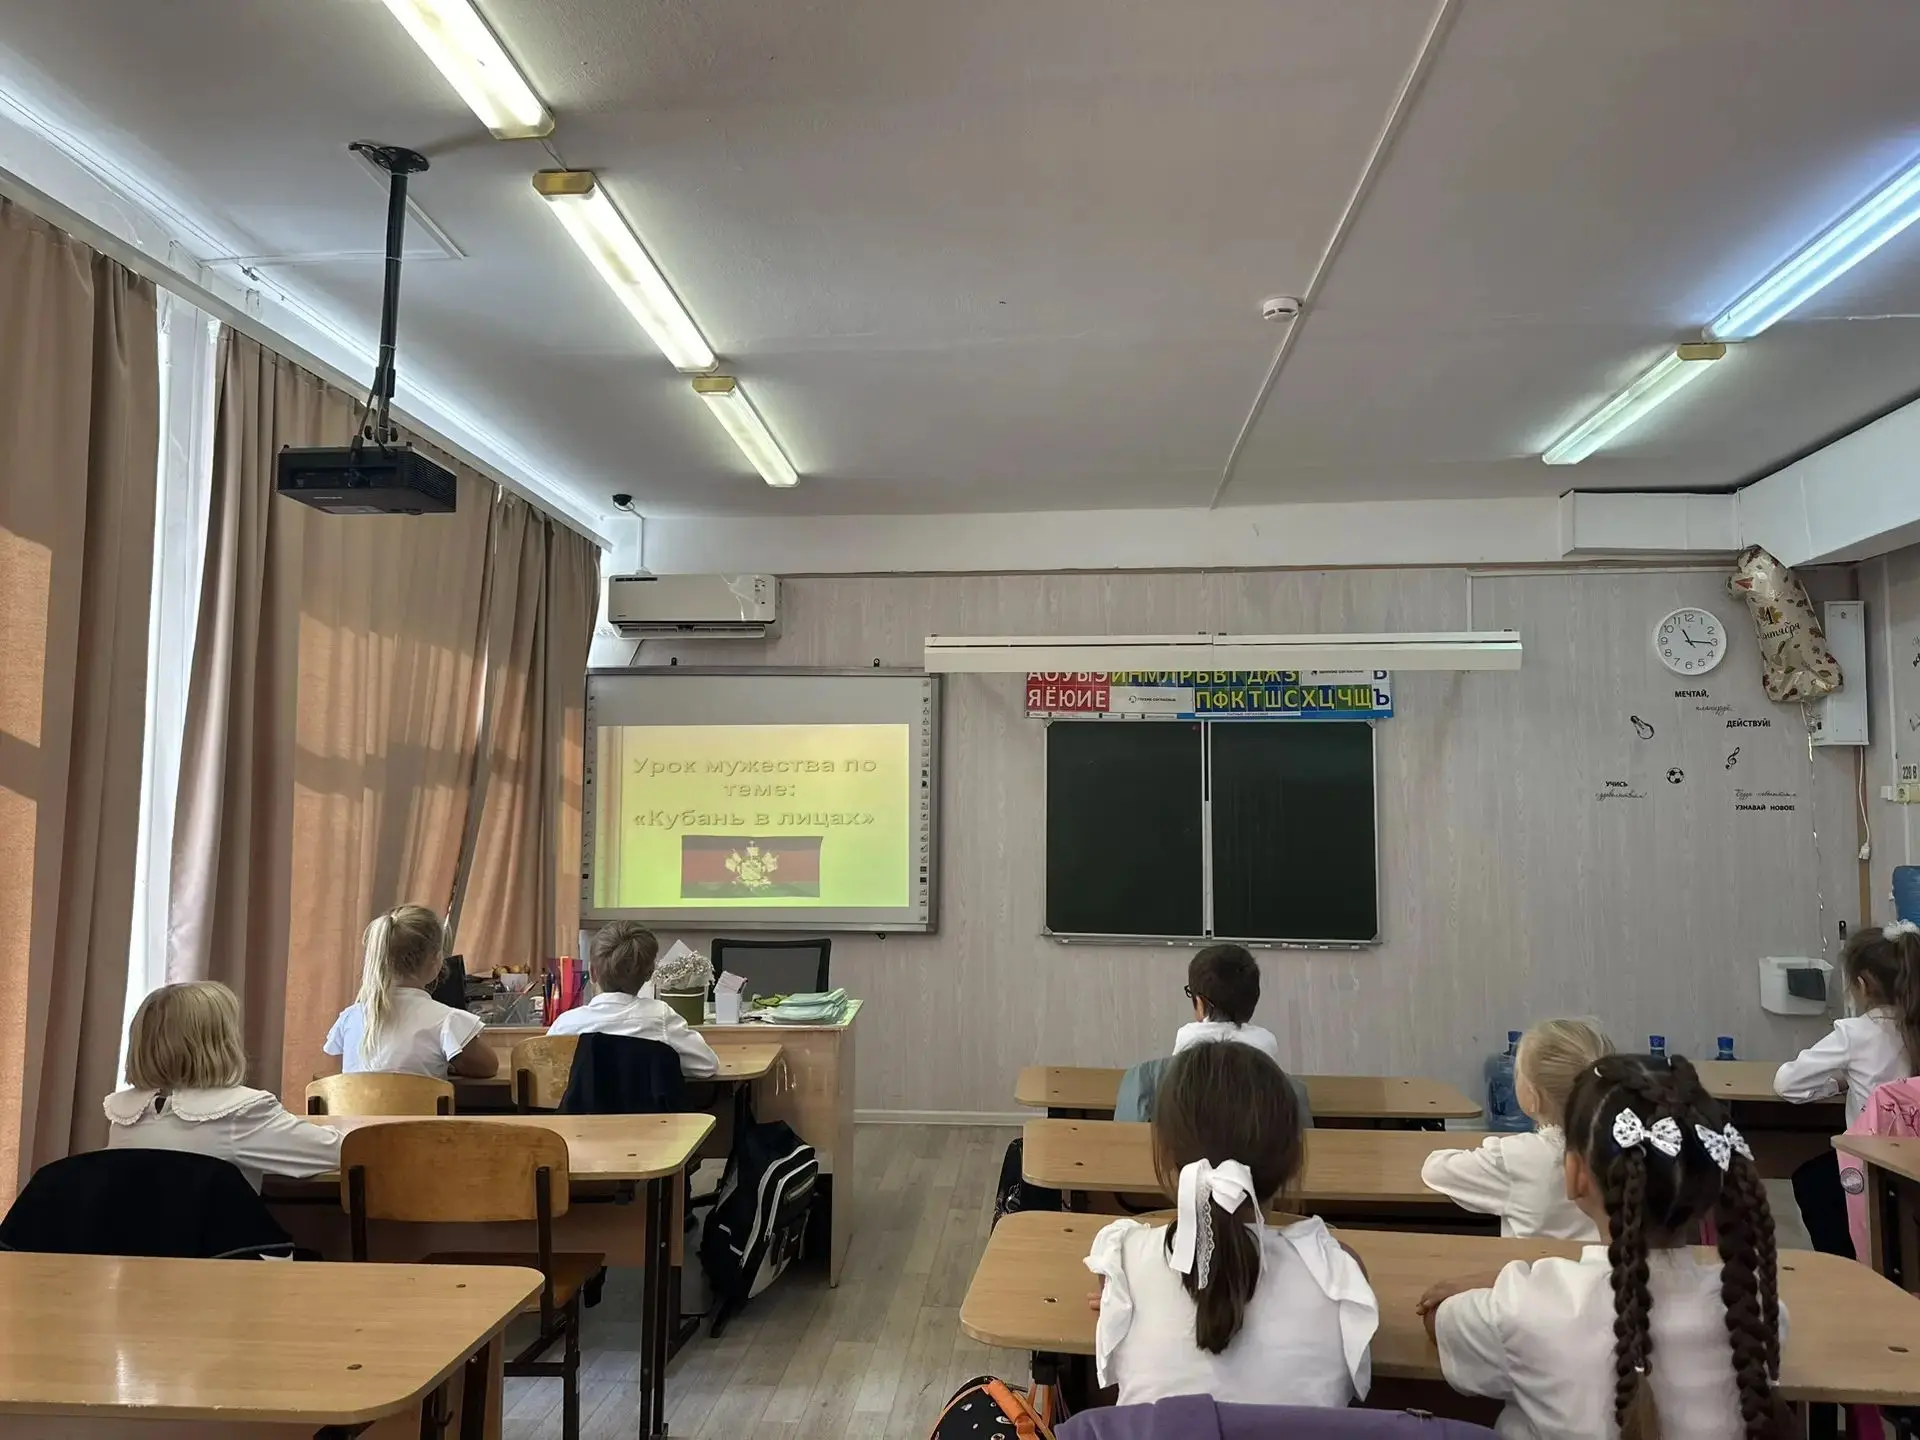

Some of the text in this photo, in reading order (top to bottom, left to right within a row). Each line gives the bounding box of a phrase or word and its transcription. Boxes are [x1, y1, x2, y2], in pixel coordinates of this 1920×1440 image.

[1673, 617, 1681, 625] 11
[1684, 614, 1695, 622] 12
[1700, 616, 1704, 625] 1
[1663, 624, 1675, 634] 10
[1707, 626, 1715, 635] 2
[1660, 636, 1668, 645] 9
[1710, 638, 1718, 647] 3
[1664, 648, 1673, 657] 8
[1706, 650, 1715, 658] 4
[1673, 657, 1681, 666] 7
[1685, 661, 1693, 670] 6
[1697, 659, 1706, 667] 5
[1674, 689, 1710, 698] МЕЧТАЙ,
[1726, 718, 1771, 728] ДЕЙСТВУЙ!
[633, 758, 877, 777] Урок мужества по
[1605, 780, 1629, 788] УЧИСЬ
[723, 785, 796, 797] теме:
[1735, 803, 1766, 811] УЗНАВАЙ
[634, 809, 875, 831] «Кубань в лицах»
